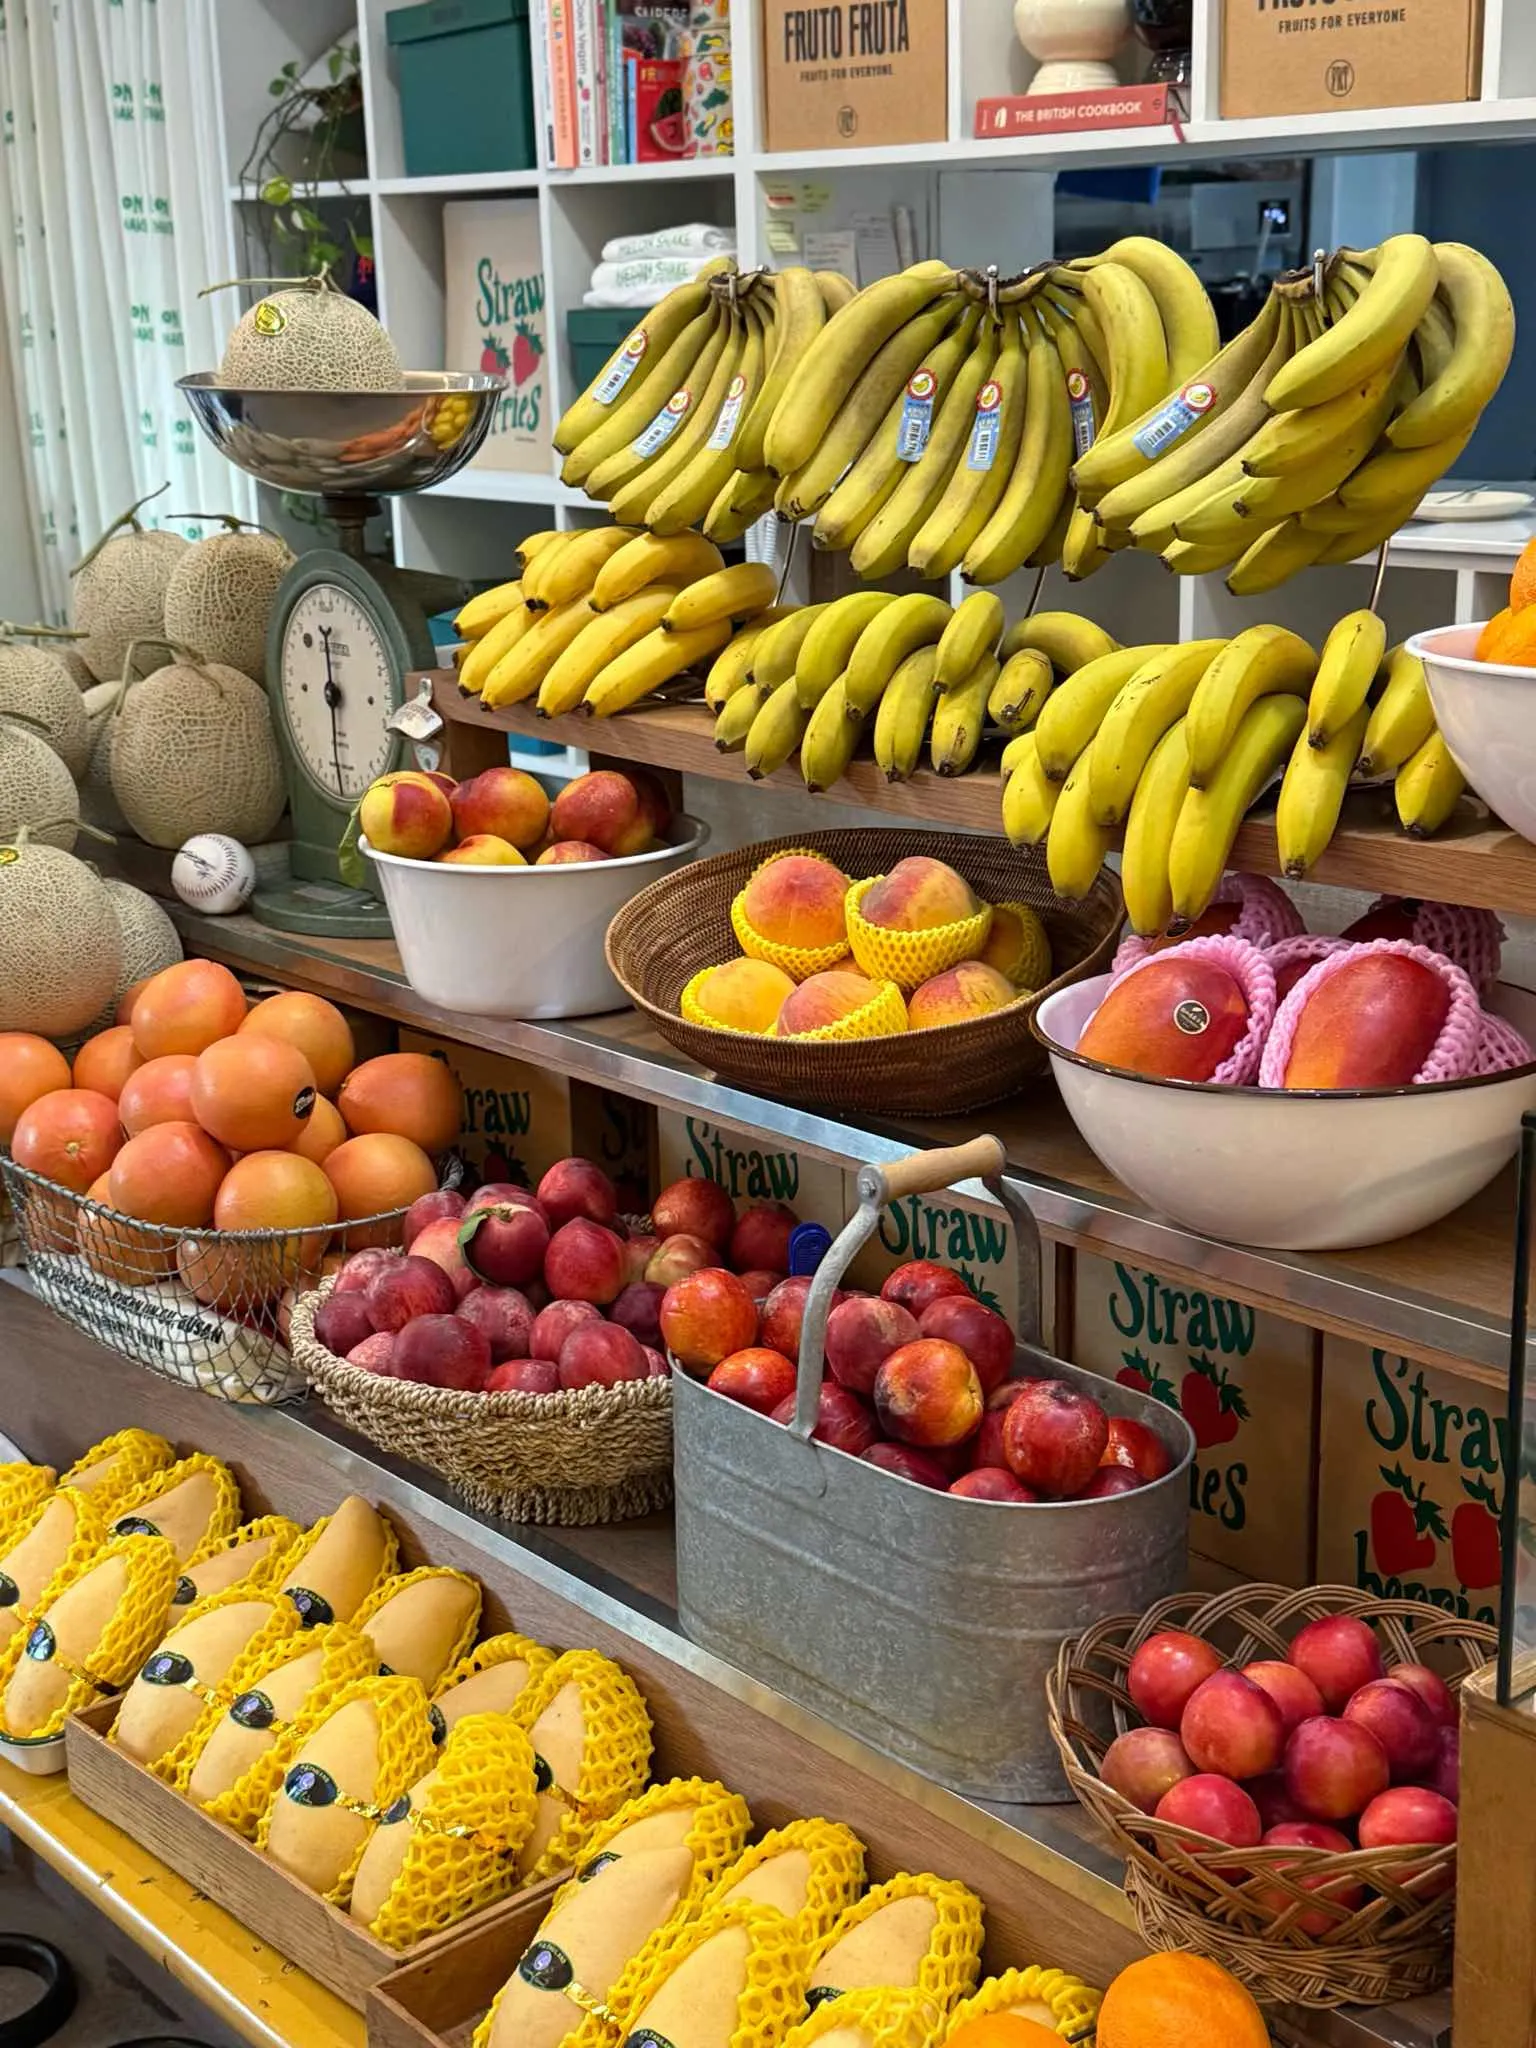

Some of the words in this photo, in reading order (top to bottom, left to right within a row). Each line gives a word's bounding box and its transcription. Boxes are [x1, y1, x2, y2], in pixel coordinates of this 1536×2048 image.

[784, 6, 843, 63] FRUTO
[849, 0, 909, 57] FRUTA
[1278, 17, 1317, 33] FRUITS
[1321, 15, 1343, 30] FOR
[1347, 8, 1406, 27] EVERYONE
[800, 69, 828, 82] FRUITS
[831, 67, 847, 79] FOR
[1015, 109, 1034, 123] THE
[1037, 106, 1076, 121] BRITISH
[1077, 102, 1142, 118] COOKBOOK
[477, 258, 545, 327] Straw
[461, 1087, 530, 1136] raw
[686, 1116, 799, 1200] Straw
[878, 1194, 1007, 1264] Straw
[177, 1314, 223, 1345] BUSAN
[1109, 1261, 1255, 1356] Straw
